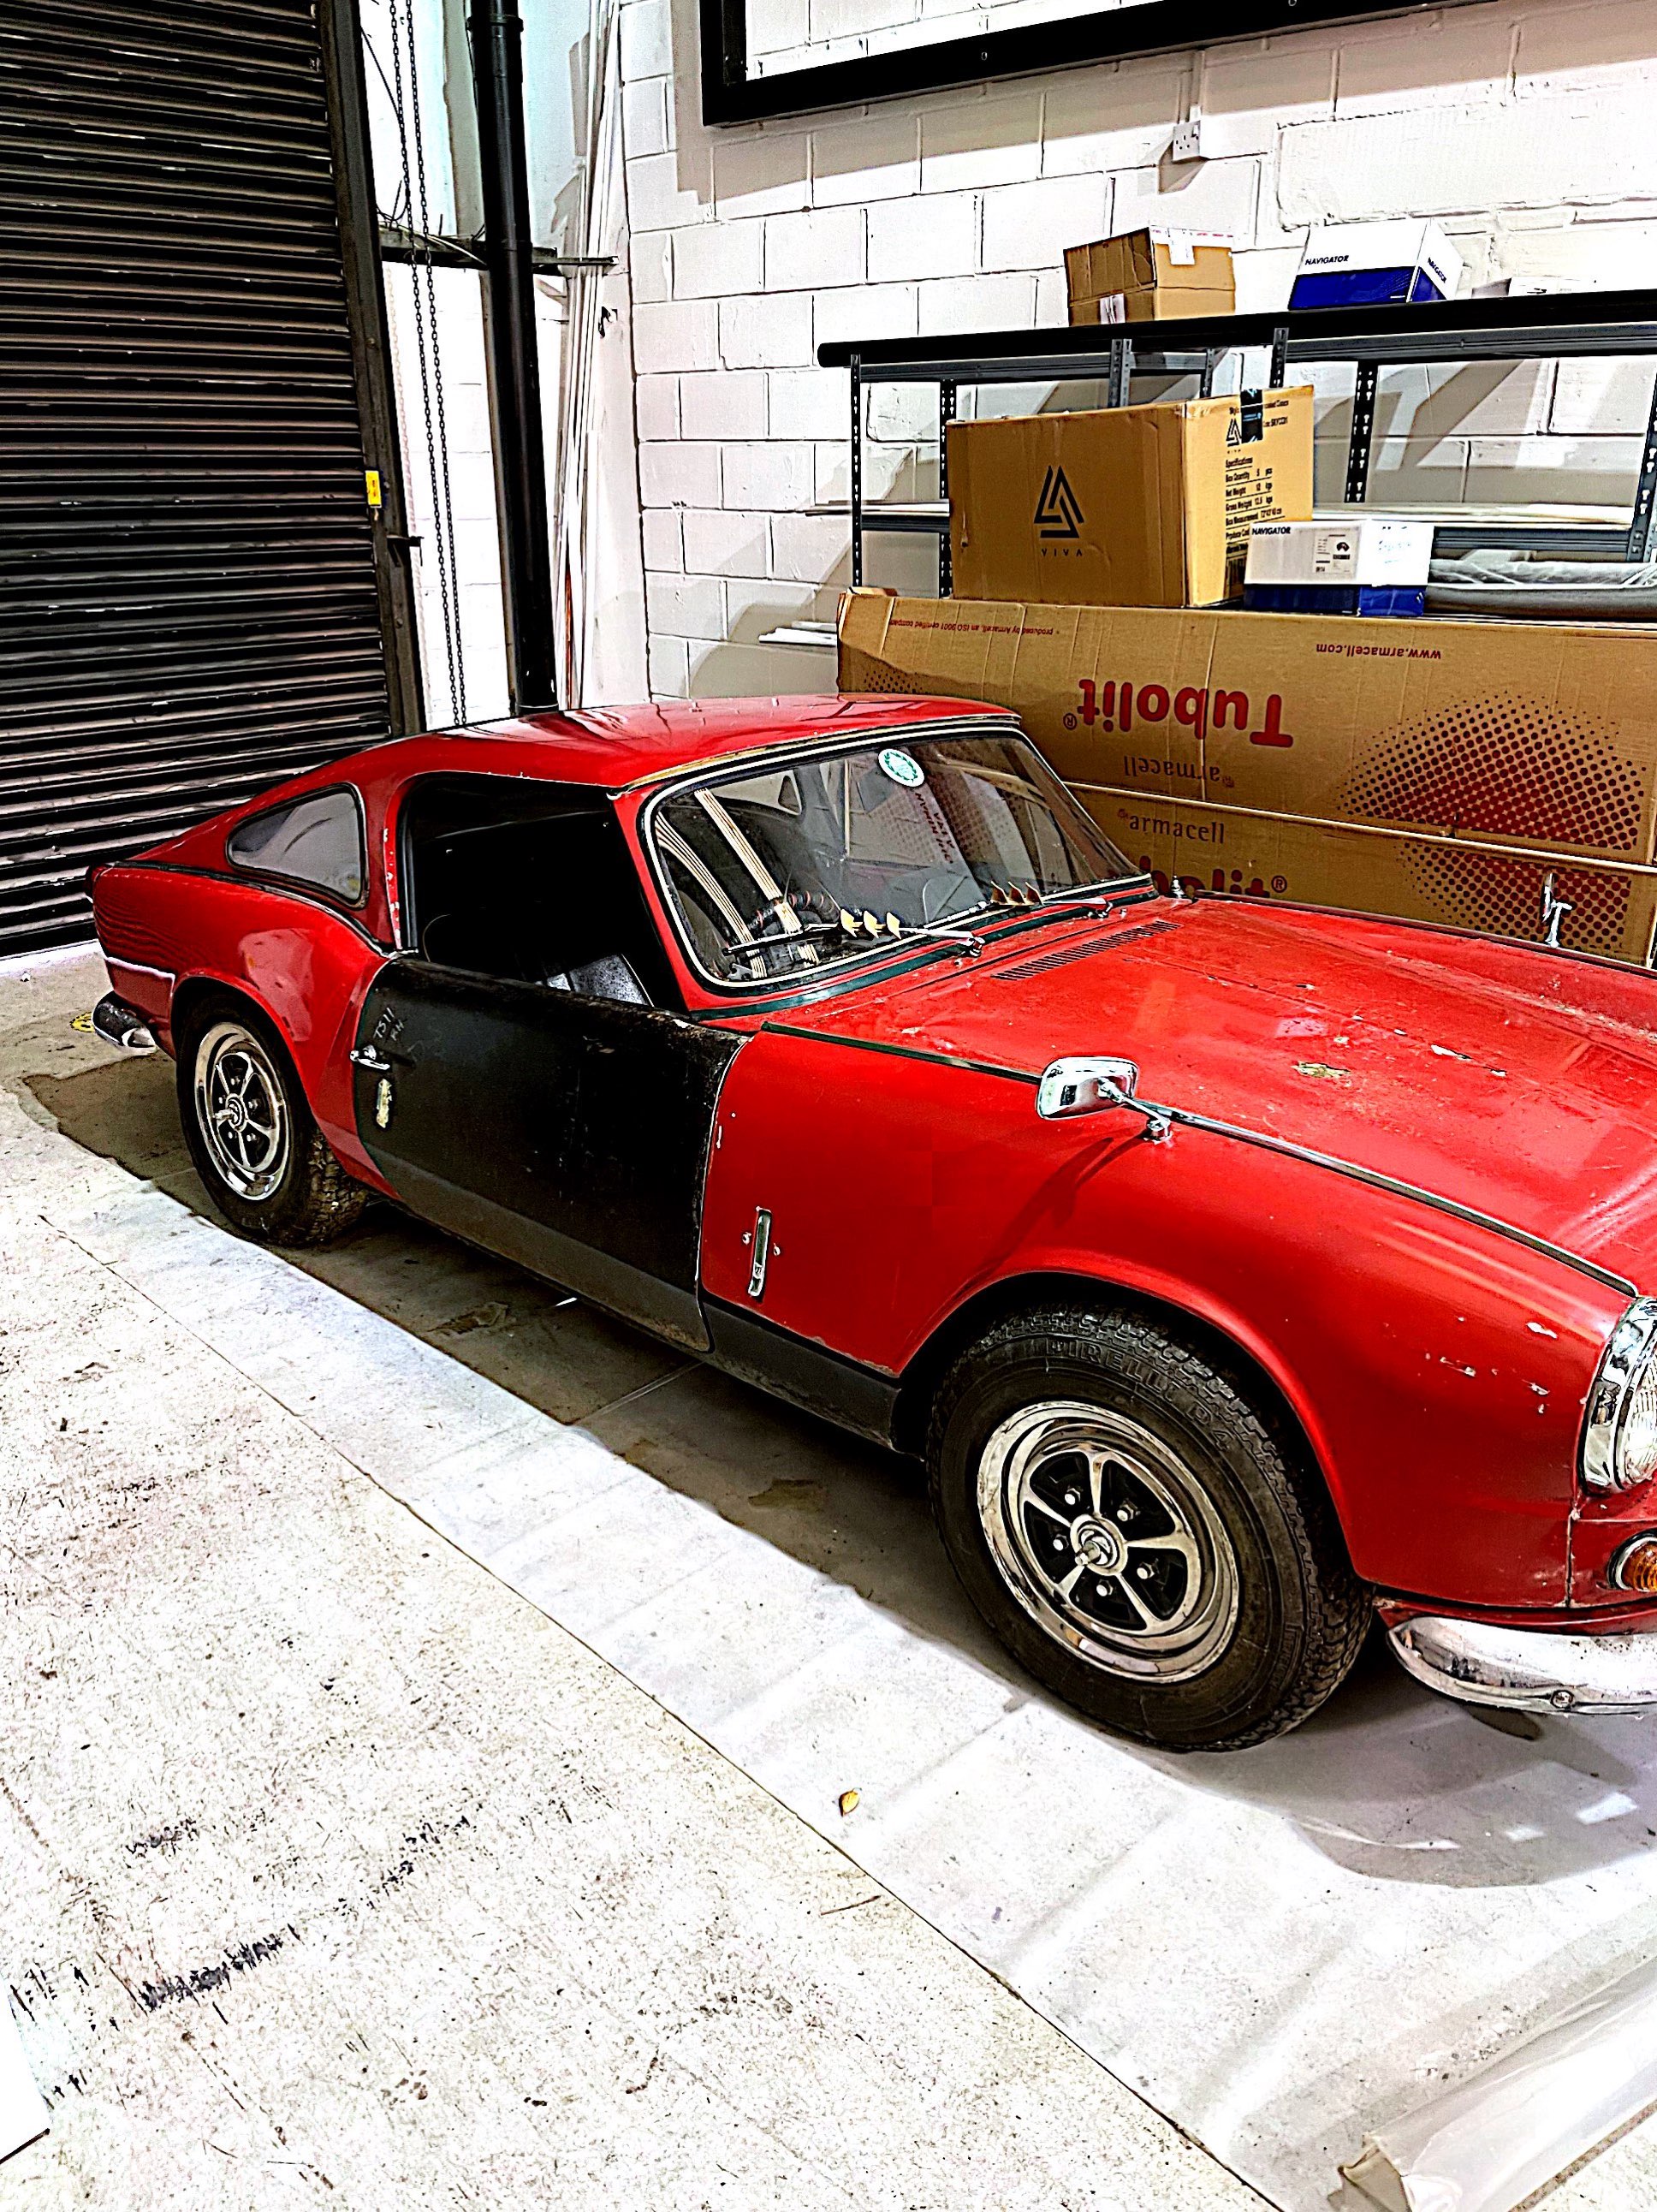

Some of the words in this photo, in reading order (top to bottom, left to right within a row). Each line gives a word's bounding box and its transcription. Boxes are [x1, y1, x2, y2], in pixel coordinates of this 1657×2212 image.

[1304, 254, 1350, 265] NAVIGATOR
[1251, 526, 1291, 536] NAVIGATOR
[1041, 548, 1083, 557] VIVA
[957, 622, 970, 631] ISO
[1316, 643, 1441, 659] www.armacell.com
[1123, 755, 1221, 782] armacell
[1129, 814, 1225, 844] armacell
[1045, 1337, 1182, 1402] PIRELLI
